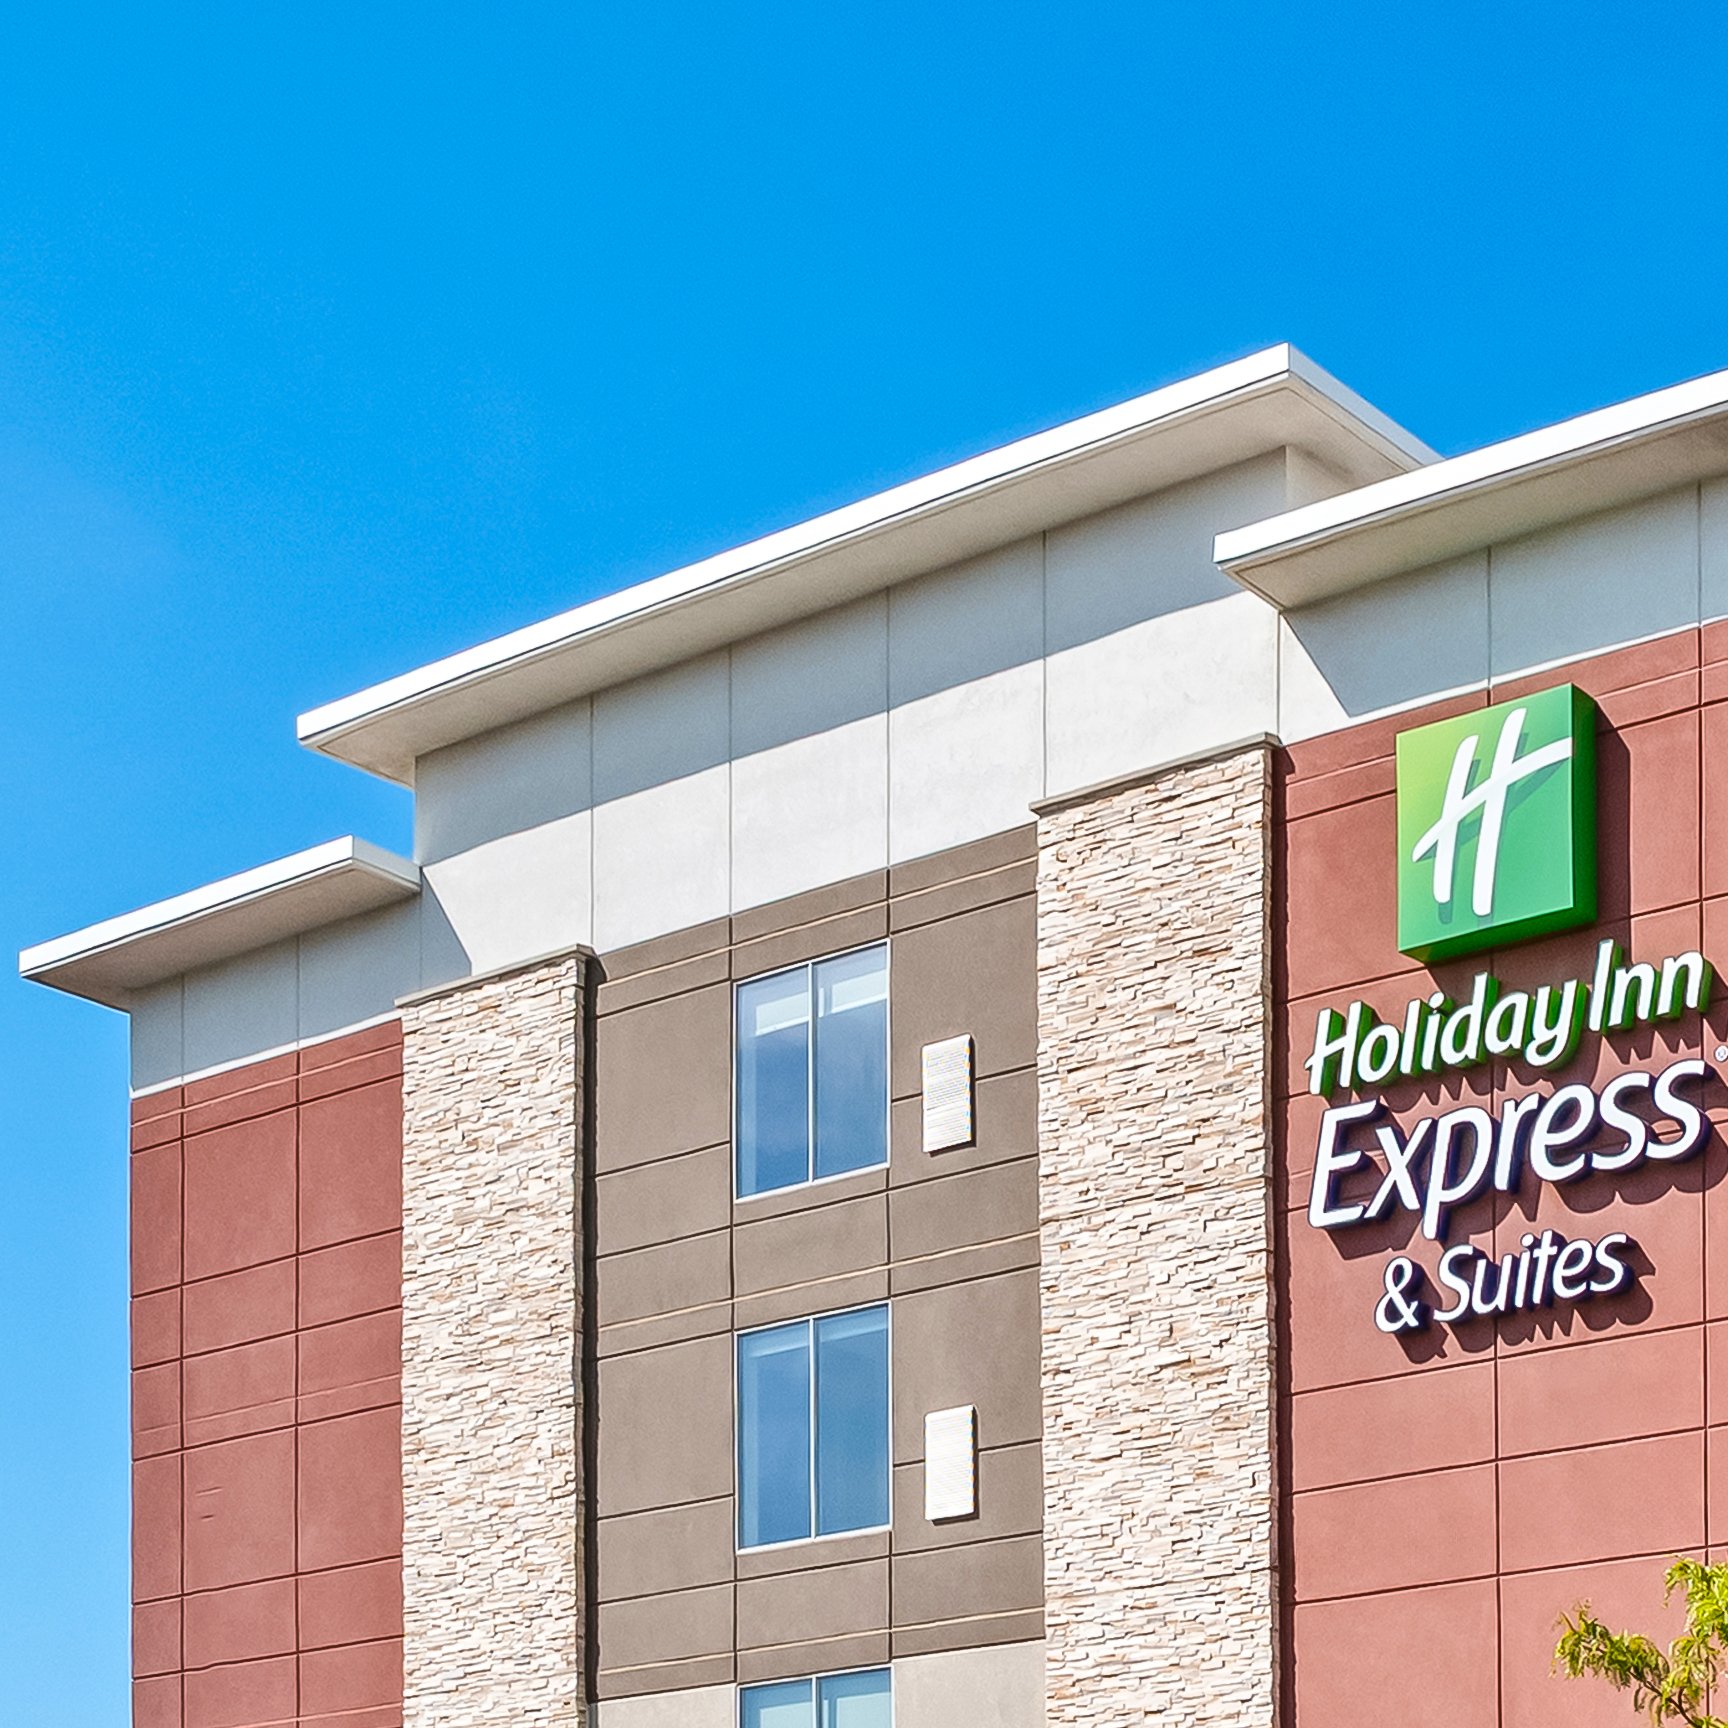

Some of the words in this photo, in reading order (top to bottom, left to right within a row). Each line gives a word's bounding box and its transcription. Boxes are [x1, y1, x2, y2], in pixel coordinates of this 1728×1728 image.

[1411, 707, 1573, 917] H
[1303, 971, 1580, 1096] Holiday
[1587, 938, 1705, 1032] Inn
[1307, 1058, 1706, 1241] Express
[1373, 1255, 1420, 1333] &
[1433, 1229, 1628, 1323] Suites
